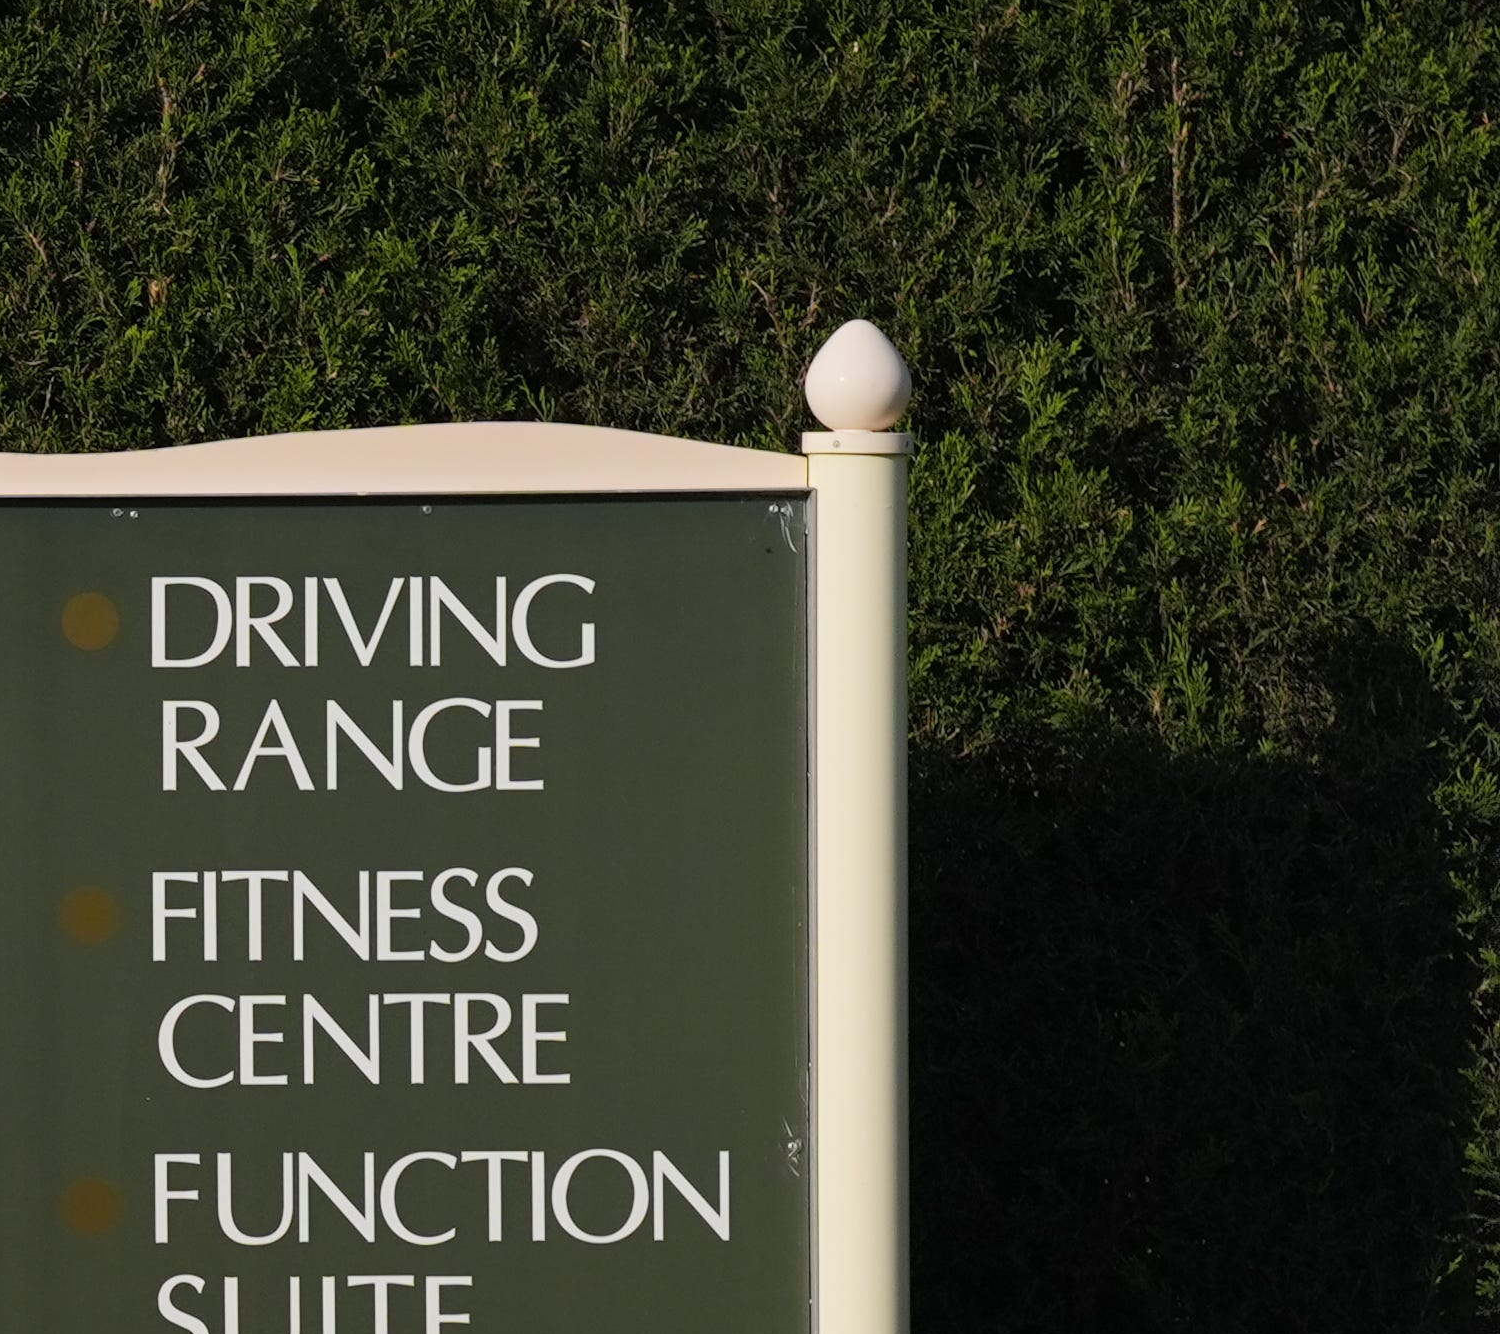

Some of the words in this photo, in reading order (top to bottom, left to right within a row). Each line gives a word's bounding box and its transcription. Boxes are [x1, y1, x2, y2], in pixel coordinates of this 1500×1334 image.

[152, 574, 595, 668] DRIVING
[163, 698, 543, 792] RANGE
[153, 868, 537, 962] FITNESS
[159, 993, 570, 1088] CENTRE
[155, 1149, 729, 1245] FUNCTION
